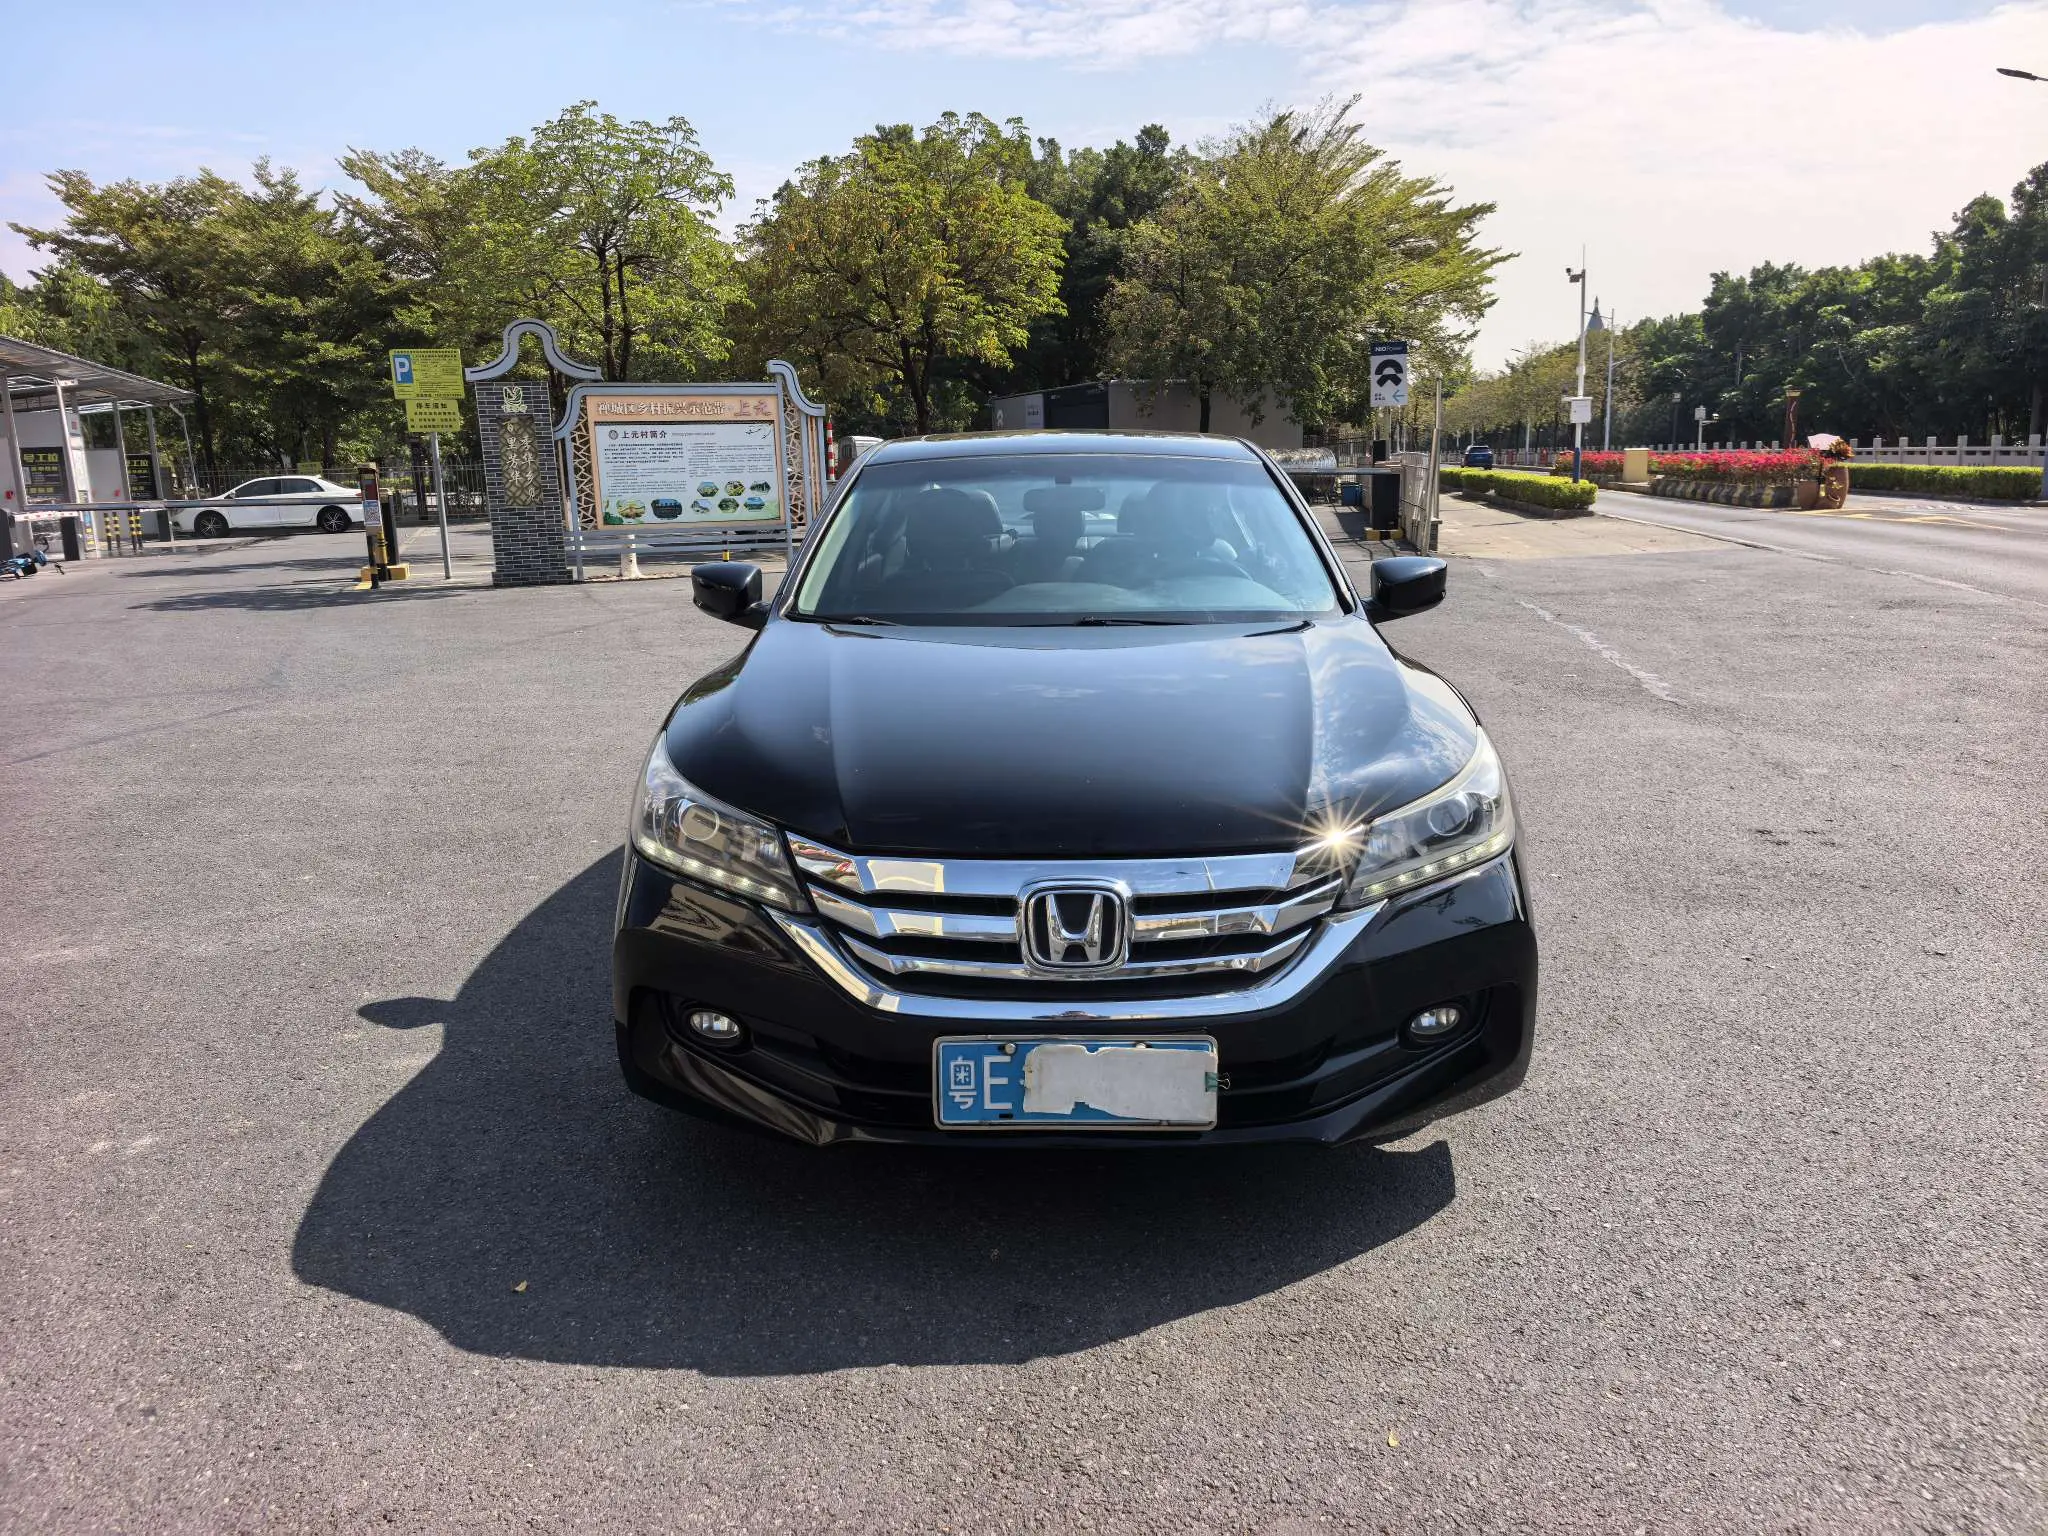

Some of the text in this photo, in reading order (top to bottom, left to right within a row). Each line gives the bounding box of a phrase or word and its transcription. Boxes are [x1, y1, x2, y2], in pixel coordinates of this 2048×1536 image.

[394, 357, 410, 382] P
[621, 429, 668, 439] 上元村简介
